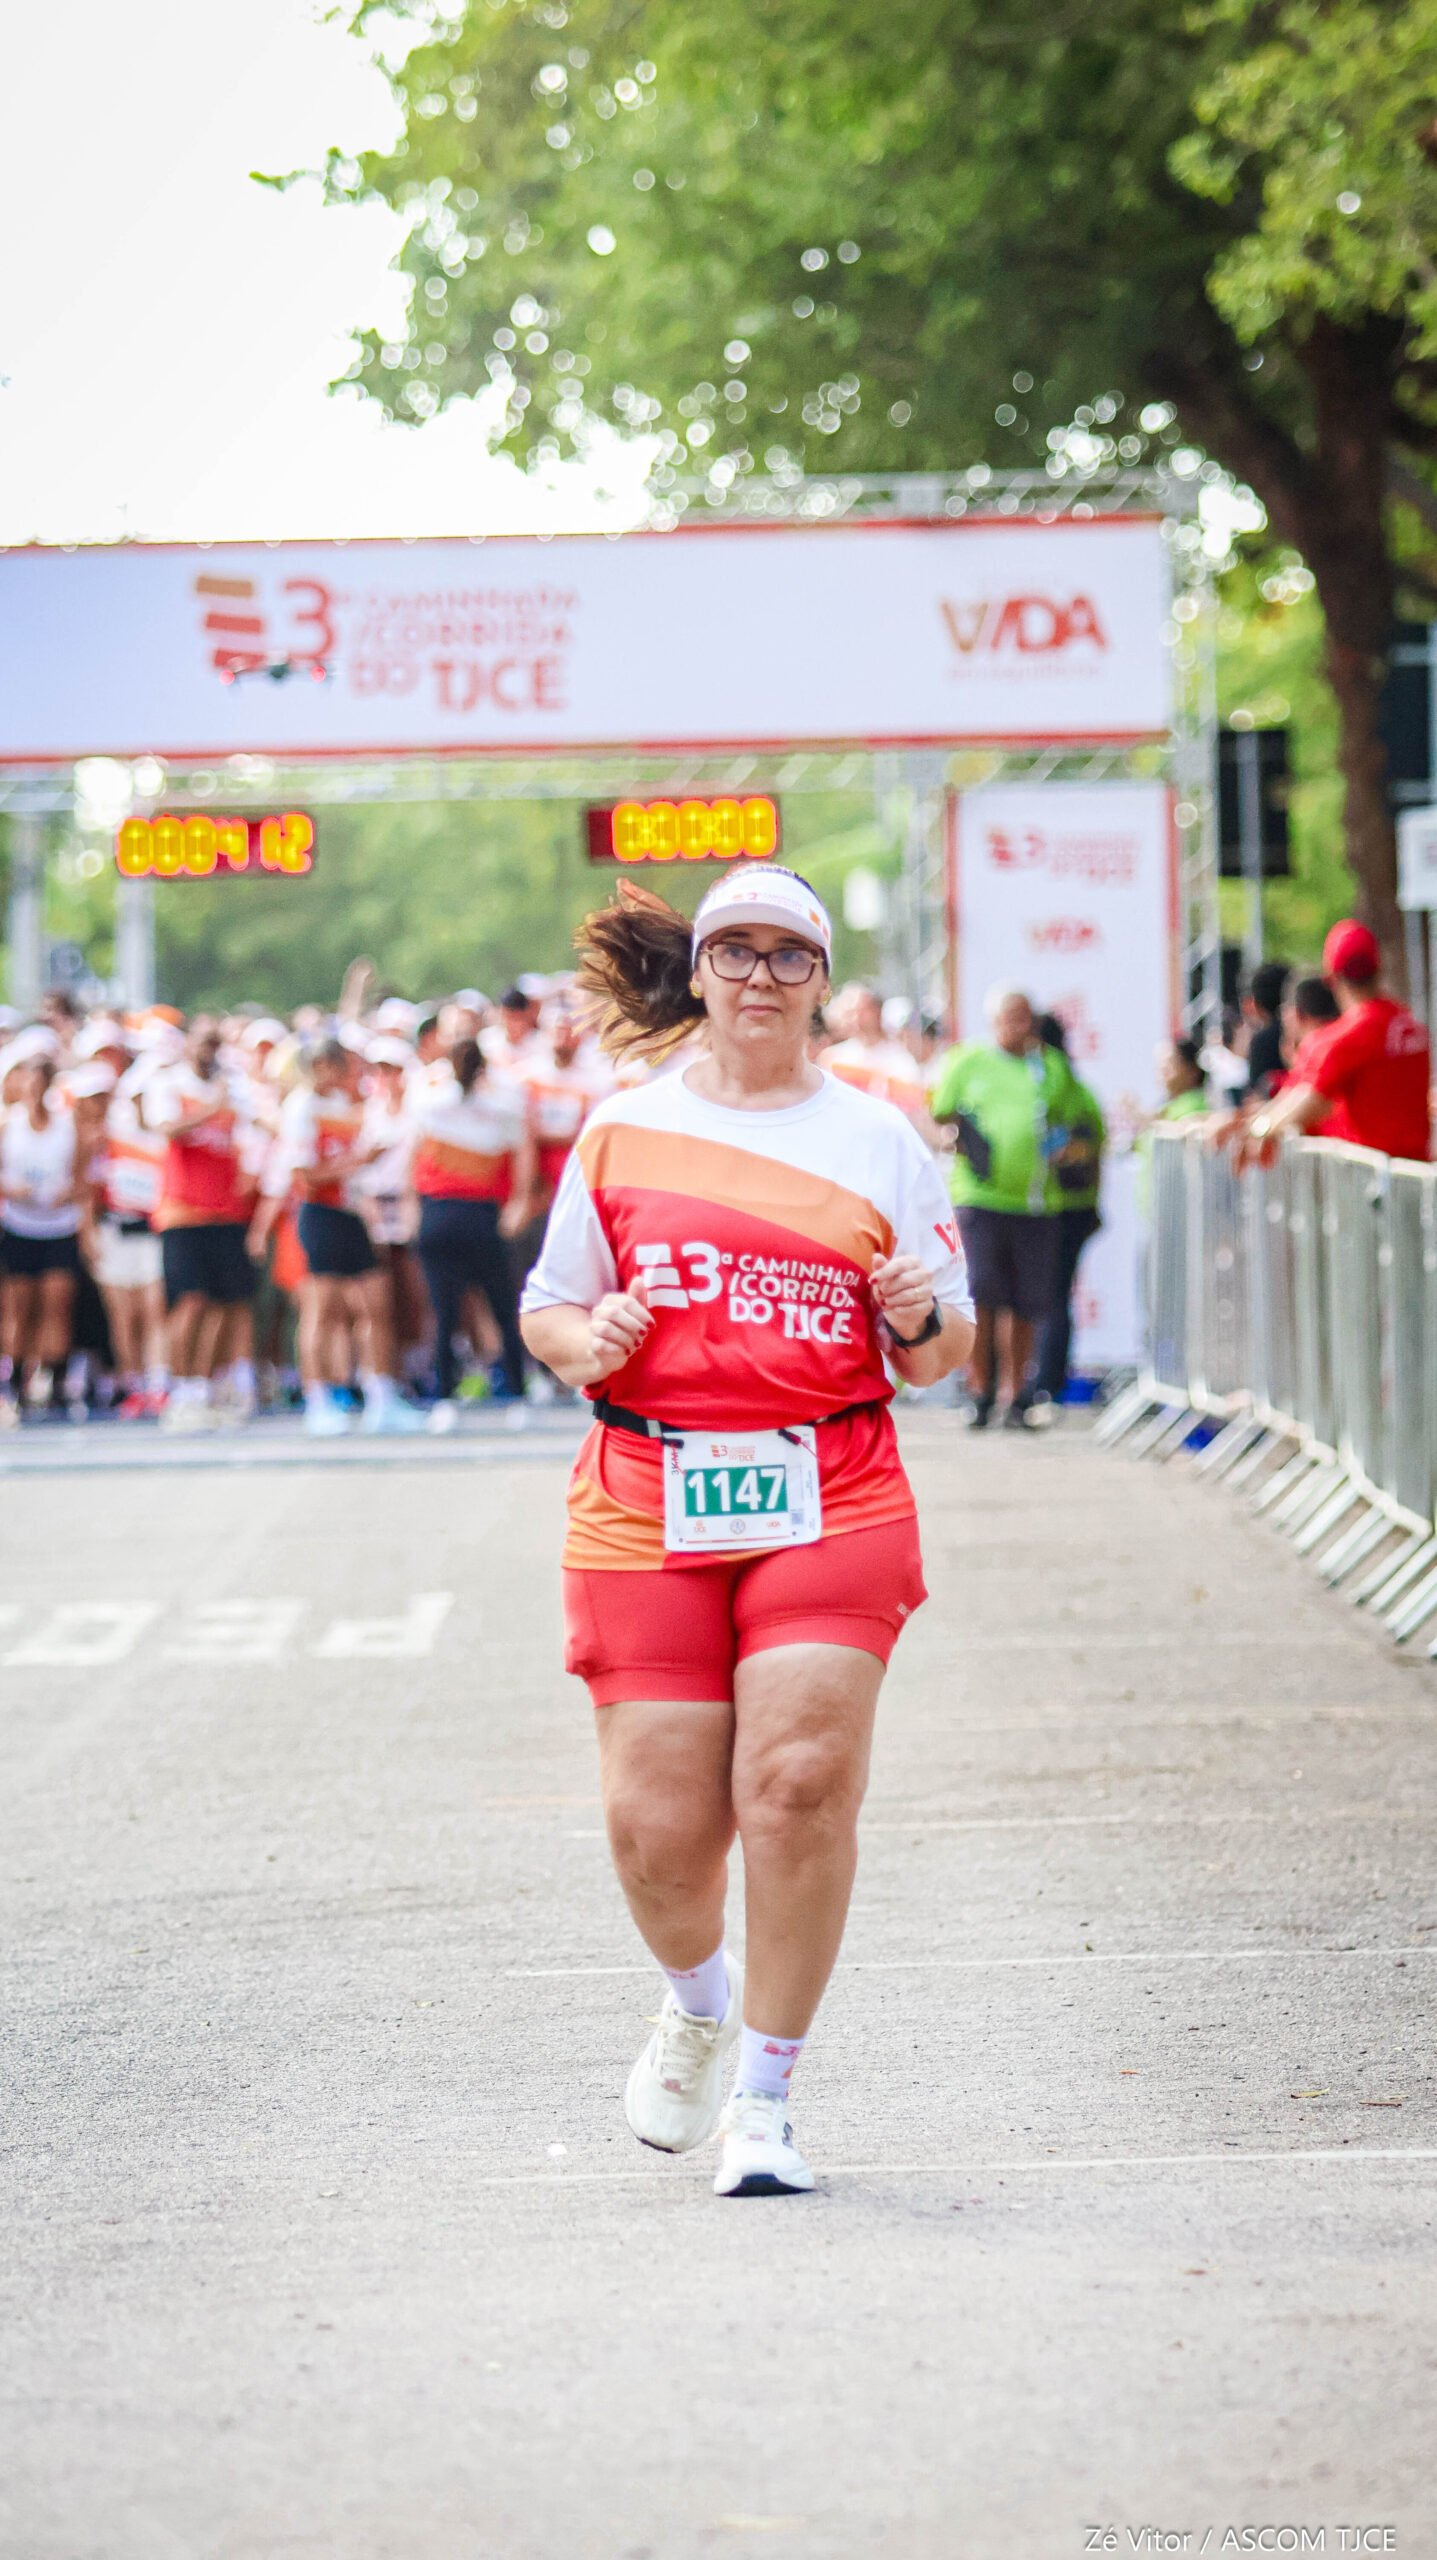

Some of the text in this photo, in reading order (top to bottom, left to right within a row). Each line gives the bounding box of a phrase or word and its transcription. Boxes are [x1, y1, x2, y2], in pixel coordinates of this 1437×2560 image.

[431, 654, 568, 712] TJCE
[738, 1254, 860, 1288] CAMINHADA
[729, 1296, 853, 1345] DO TJCE
[687, 1467, 785, 1514] 1147
